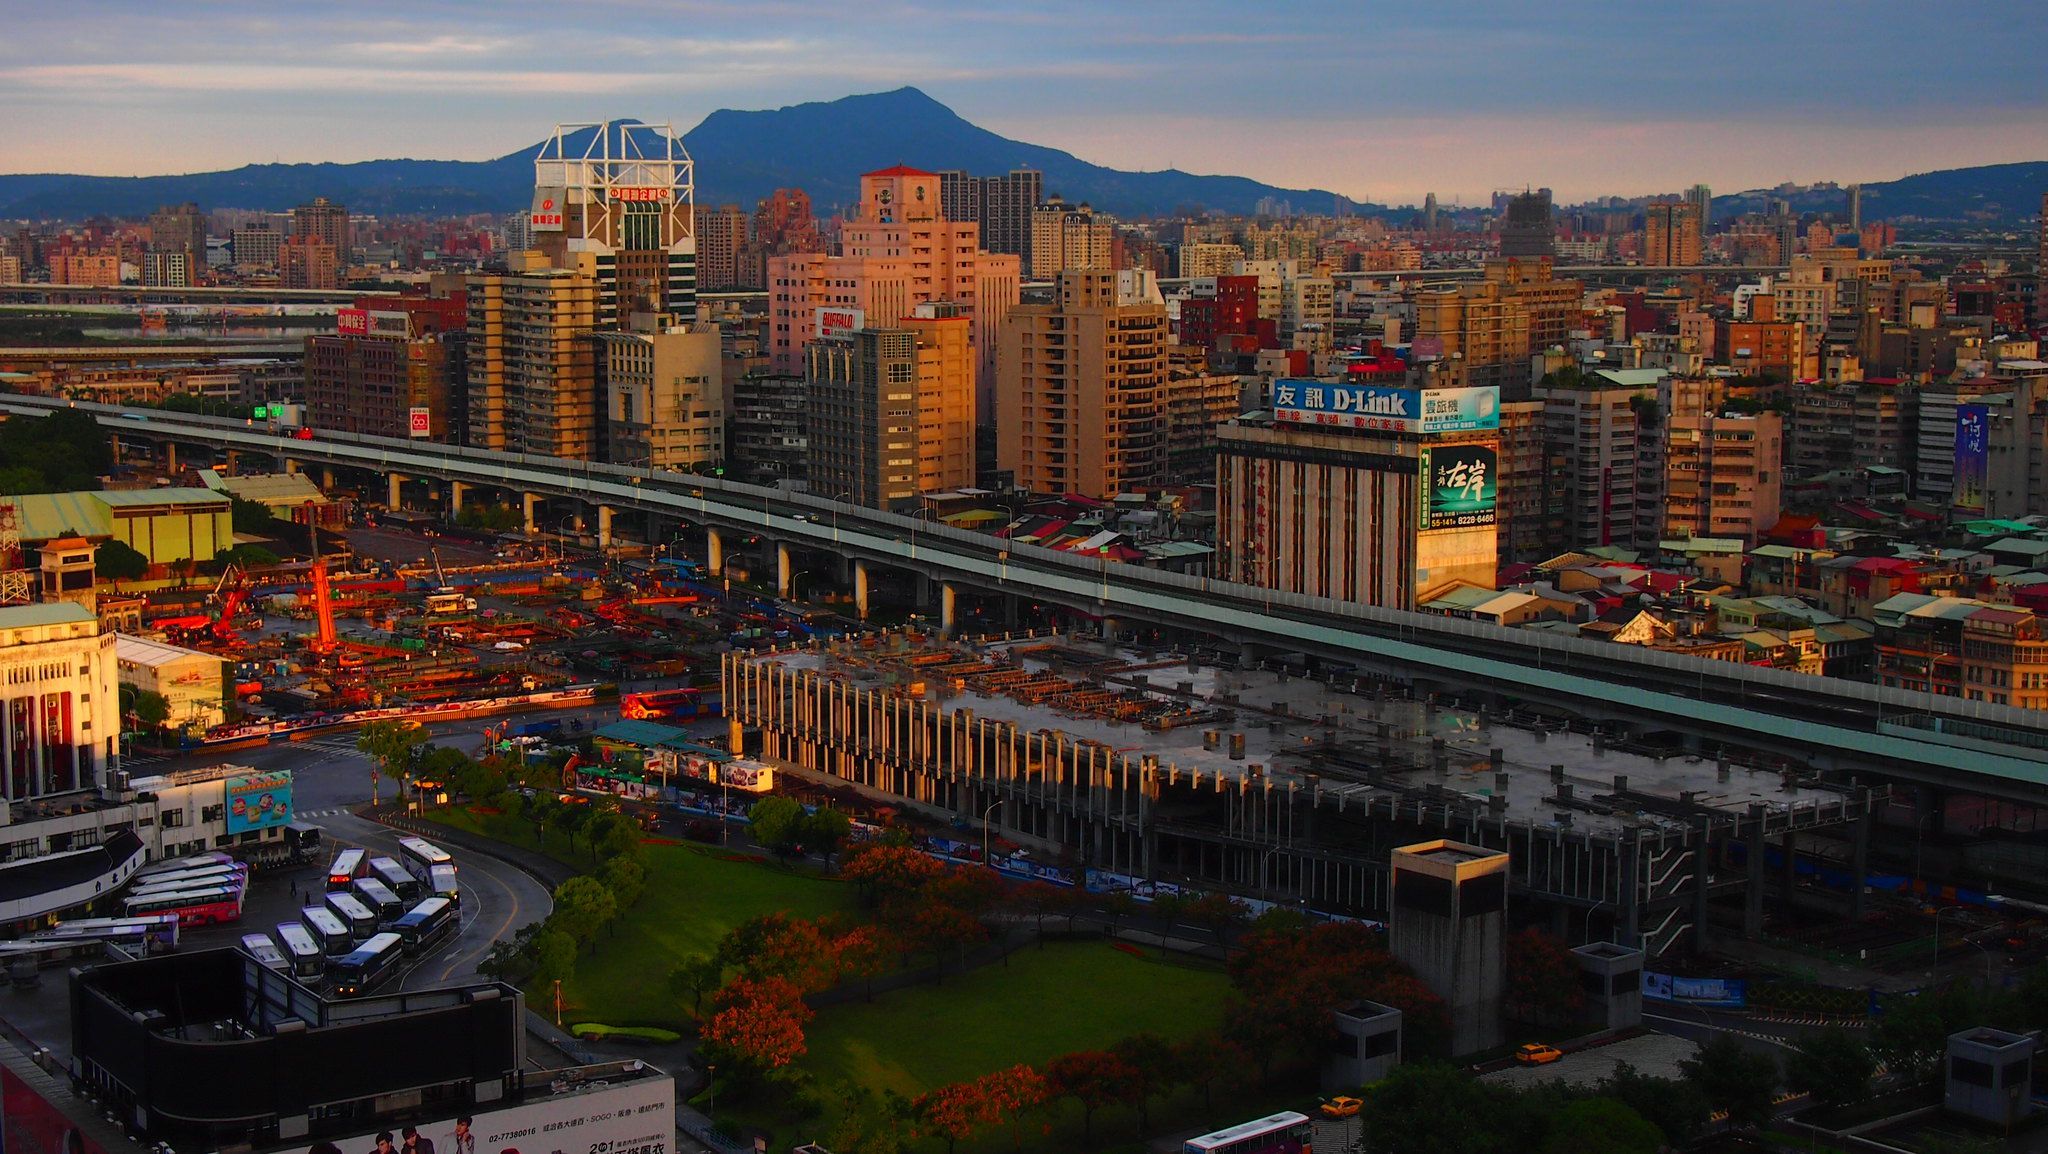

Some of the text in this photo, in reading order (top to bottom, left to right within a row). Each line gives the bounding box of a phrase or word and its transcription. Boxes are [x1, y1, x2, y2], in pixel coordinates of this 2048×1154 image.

[822, 312, 854, 329] BUFFALO
[1276, 384, 1408, 416] 友訊 D-Link
[488, 1127, 536, 1144] 02-77380016
